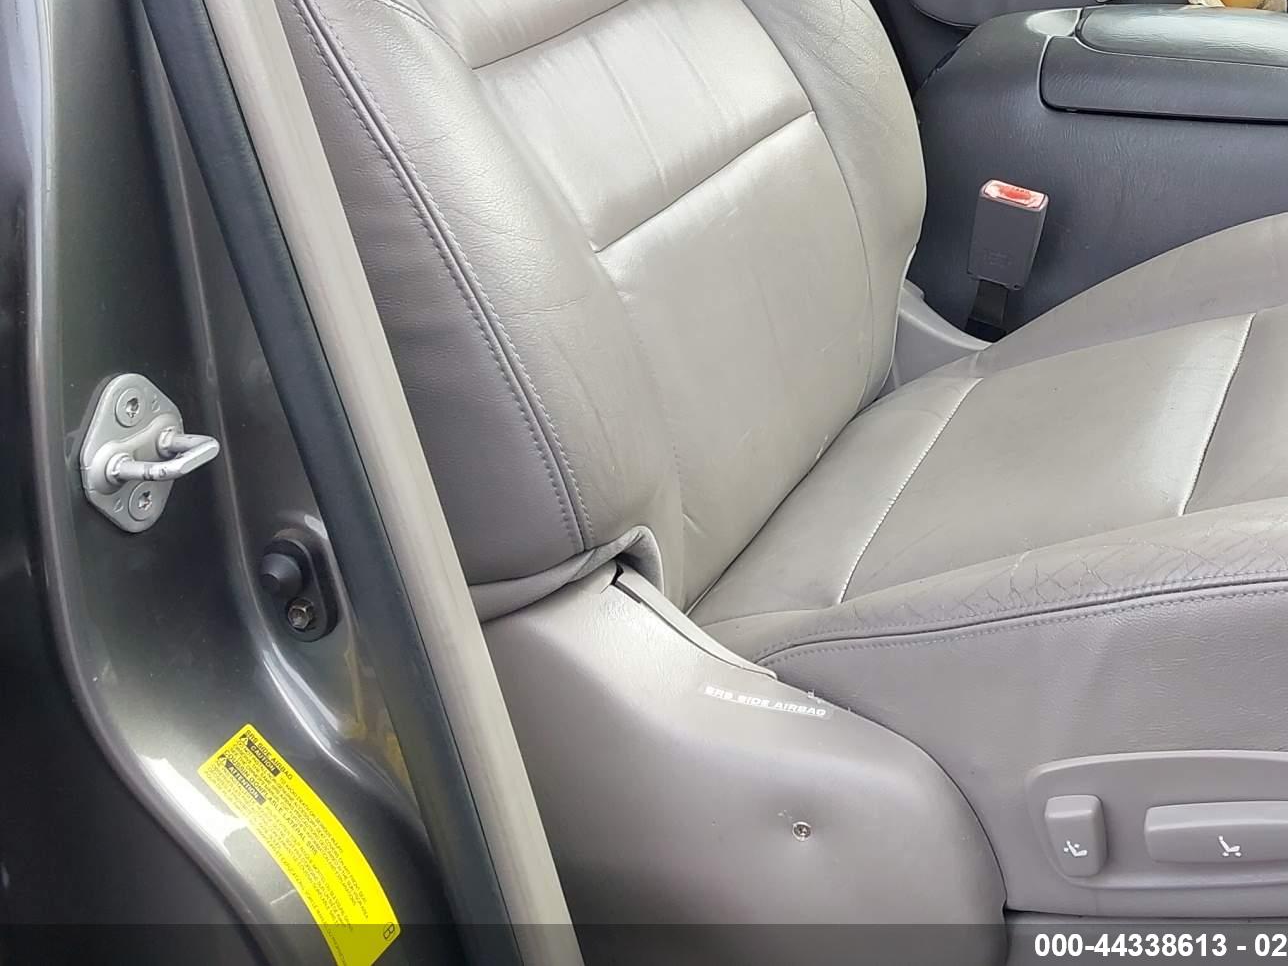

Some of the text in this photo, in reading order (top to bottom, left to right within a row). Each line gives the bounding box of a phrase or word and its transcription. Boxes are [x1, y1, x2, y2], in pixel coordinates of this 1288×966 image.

[737, 694, 770, 709] SIDE
[772, 701, 827, 718] AIRBAG
[250, 745, 276, 773] CAUTION
[271, 756, 293, 780] AIRBAG
[228, 765, 260, 799] ATTENTION
